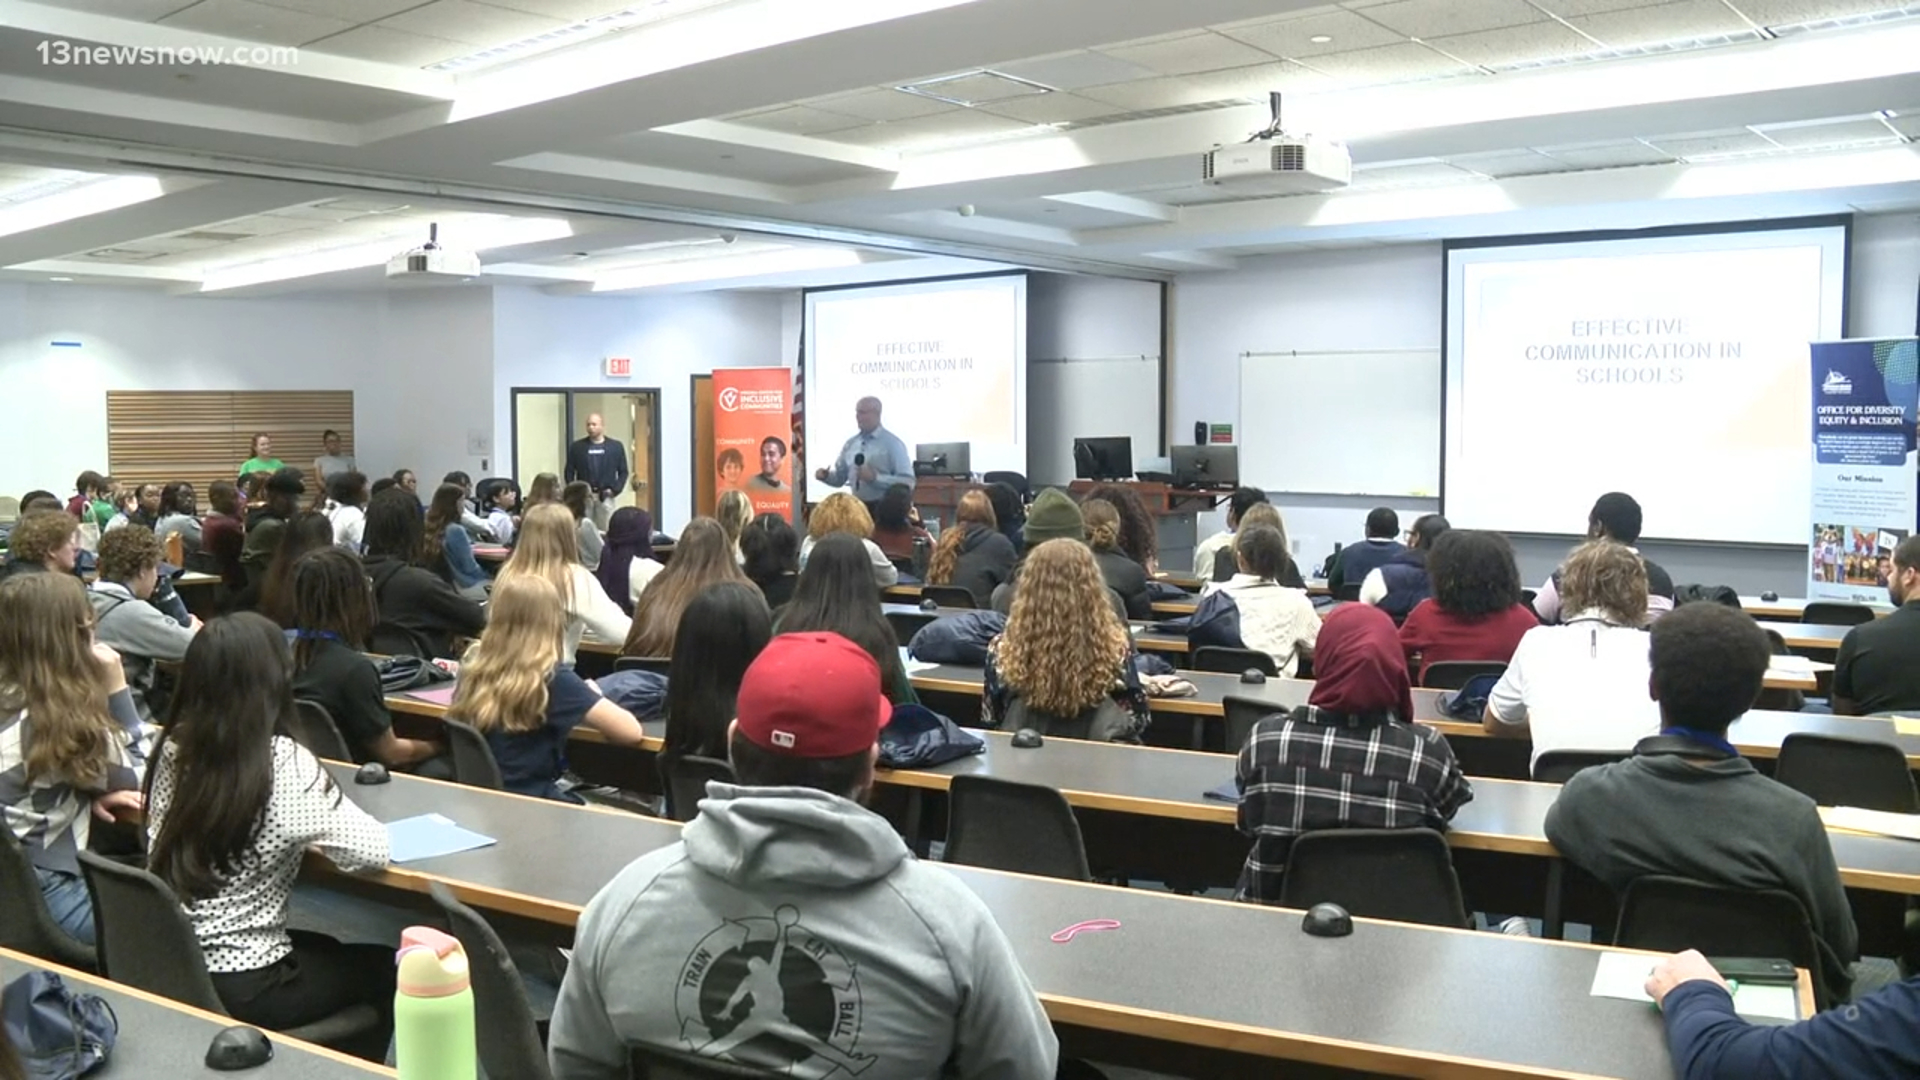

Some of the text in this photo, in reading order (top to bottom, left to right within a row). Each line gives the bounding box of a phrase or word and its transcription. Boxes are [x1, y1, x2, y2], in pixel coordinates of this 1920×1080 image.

[1571, 318, 1689, 337] EFFECTIVE
[876, 340, 945, 356] EFFECTIVE
[1524, 341, 1742, 361] COMMUNICATION IN
[610, 359, 631, 374] EXIT
[850, 357, 973, 375] COMMUNICATION IN
[880, 376, 942, 391] SCHOOLS
[1576, 366, 1684, 385] SCHOOLS
[740, 395, 783, 403] INCLUSIVE
[1817, 405, 1906, 415] OFFICE FOR DIVERSITY
[1819, 416, 1903, 426] EQUITY & INCLUSION
[1837, 474, 1852, 482] Our
[756, 501, 789, 509] EQUALITY
[804, 937, 832, 962] EAT
[682, 947, 713, 989] TRAIN
[833, 1001, 855, 1039] BALL
